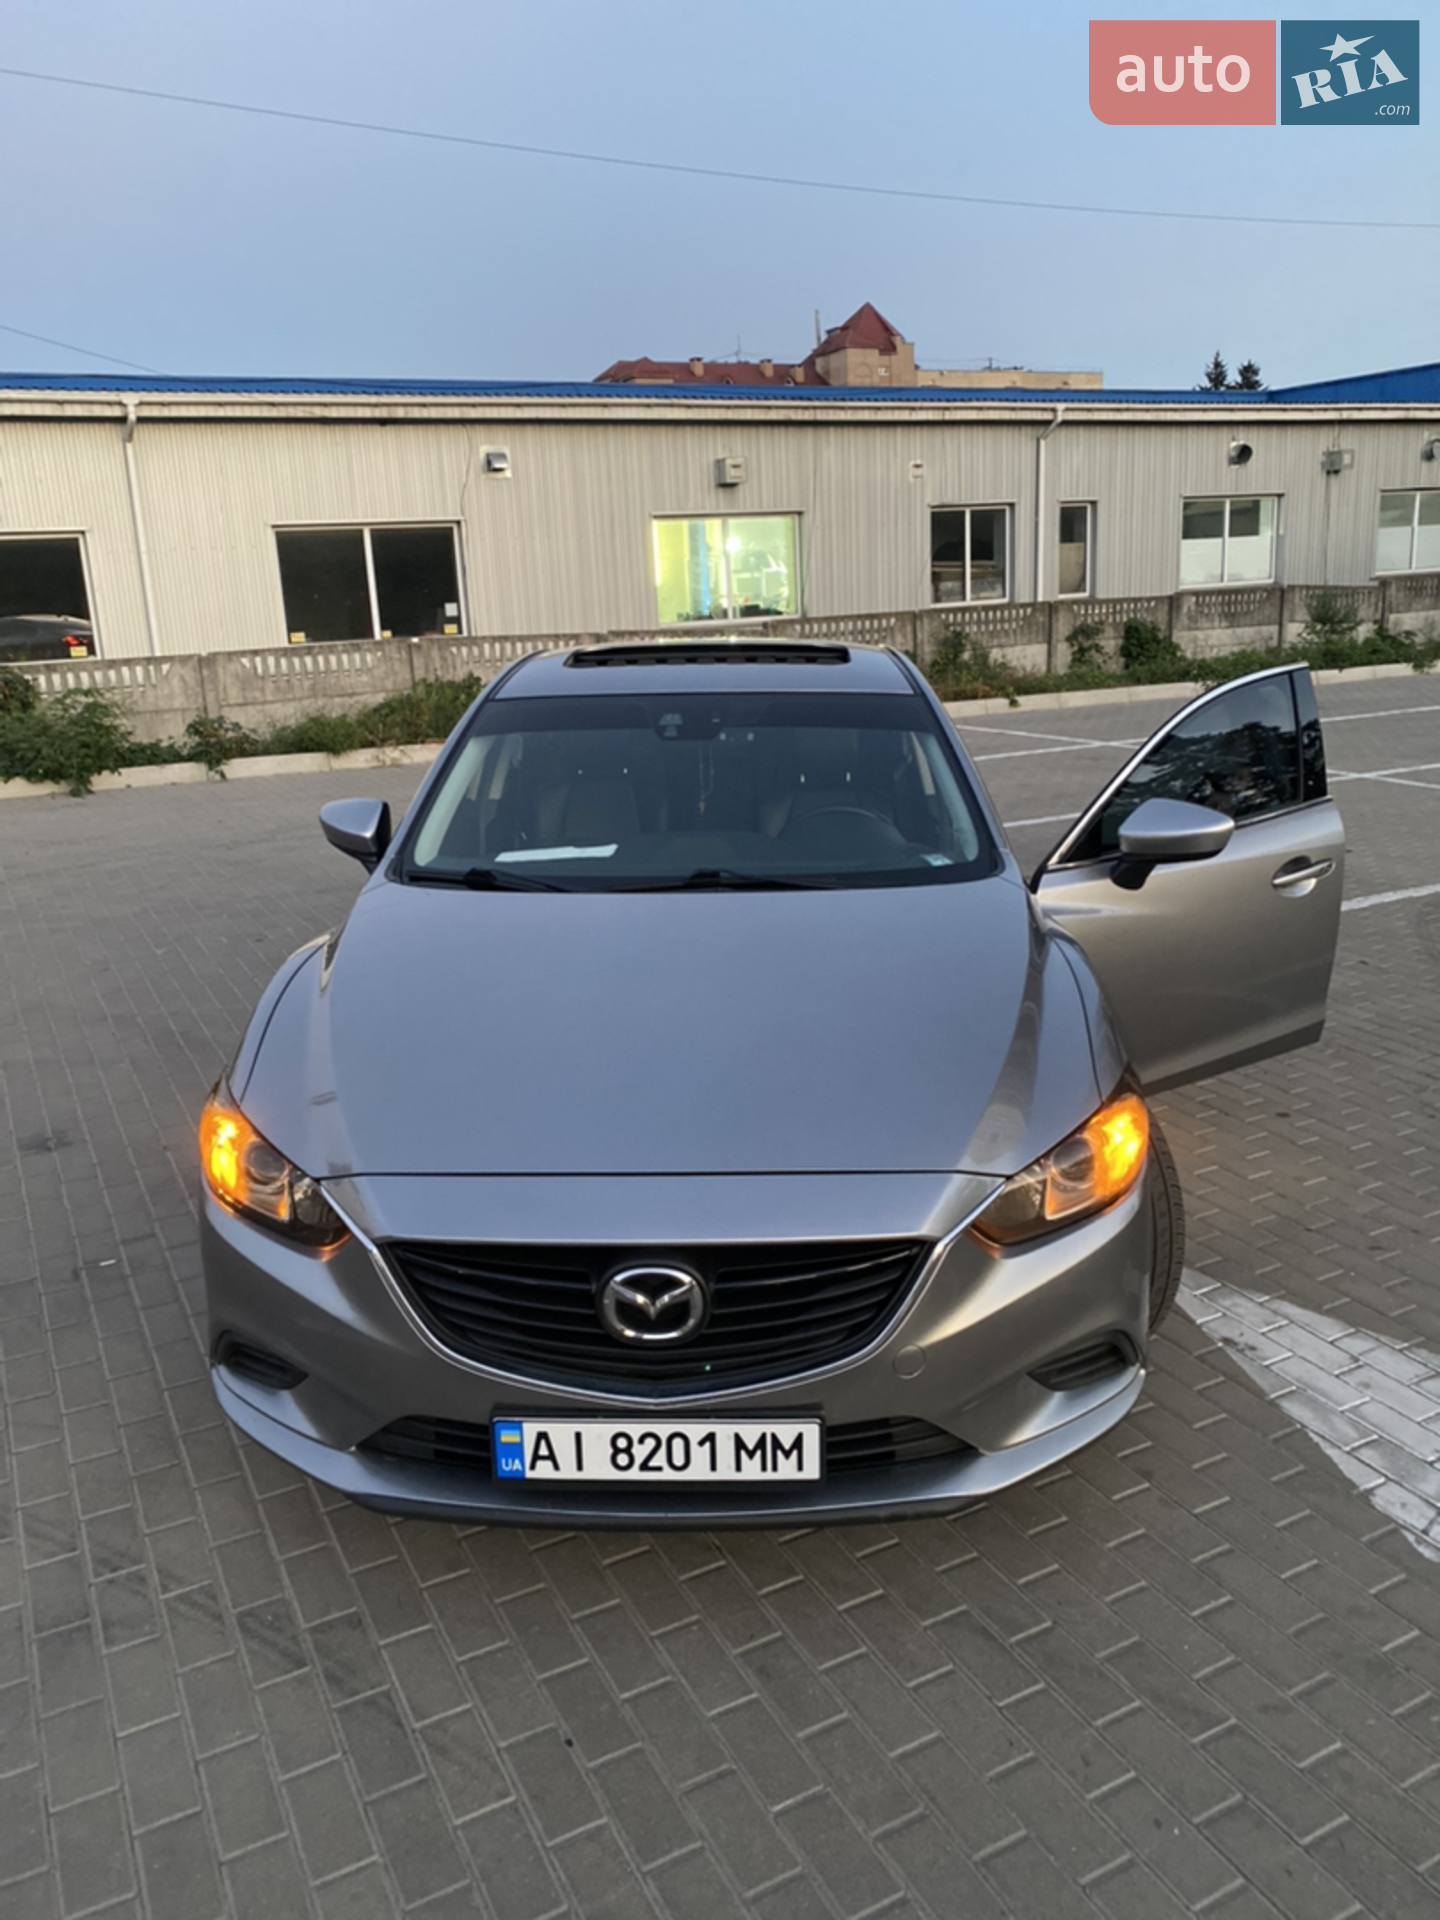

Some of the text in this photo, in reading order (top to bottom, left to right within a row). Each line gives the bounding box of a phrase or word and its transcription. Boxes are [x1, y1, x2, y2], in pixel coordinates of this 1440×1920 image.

[501, 1457, 523, 1472] UA
[609, 1431, 717, 1473] 8201
[734, 1432, 804, 1473] MM
